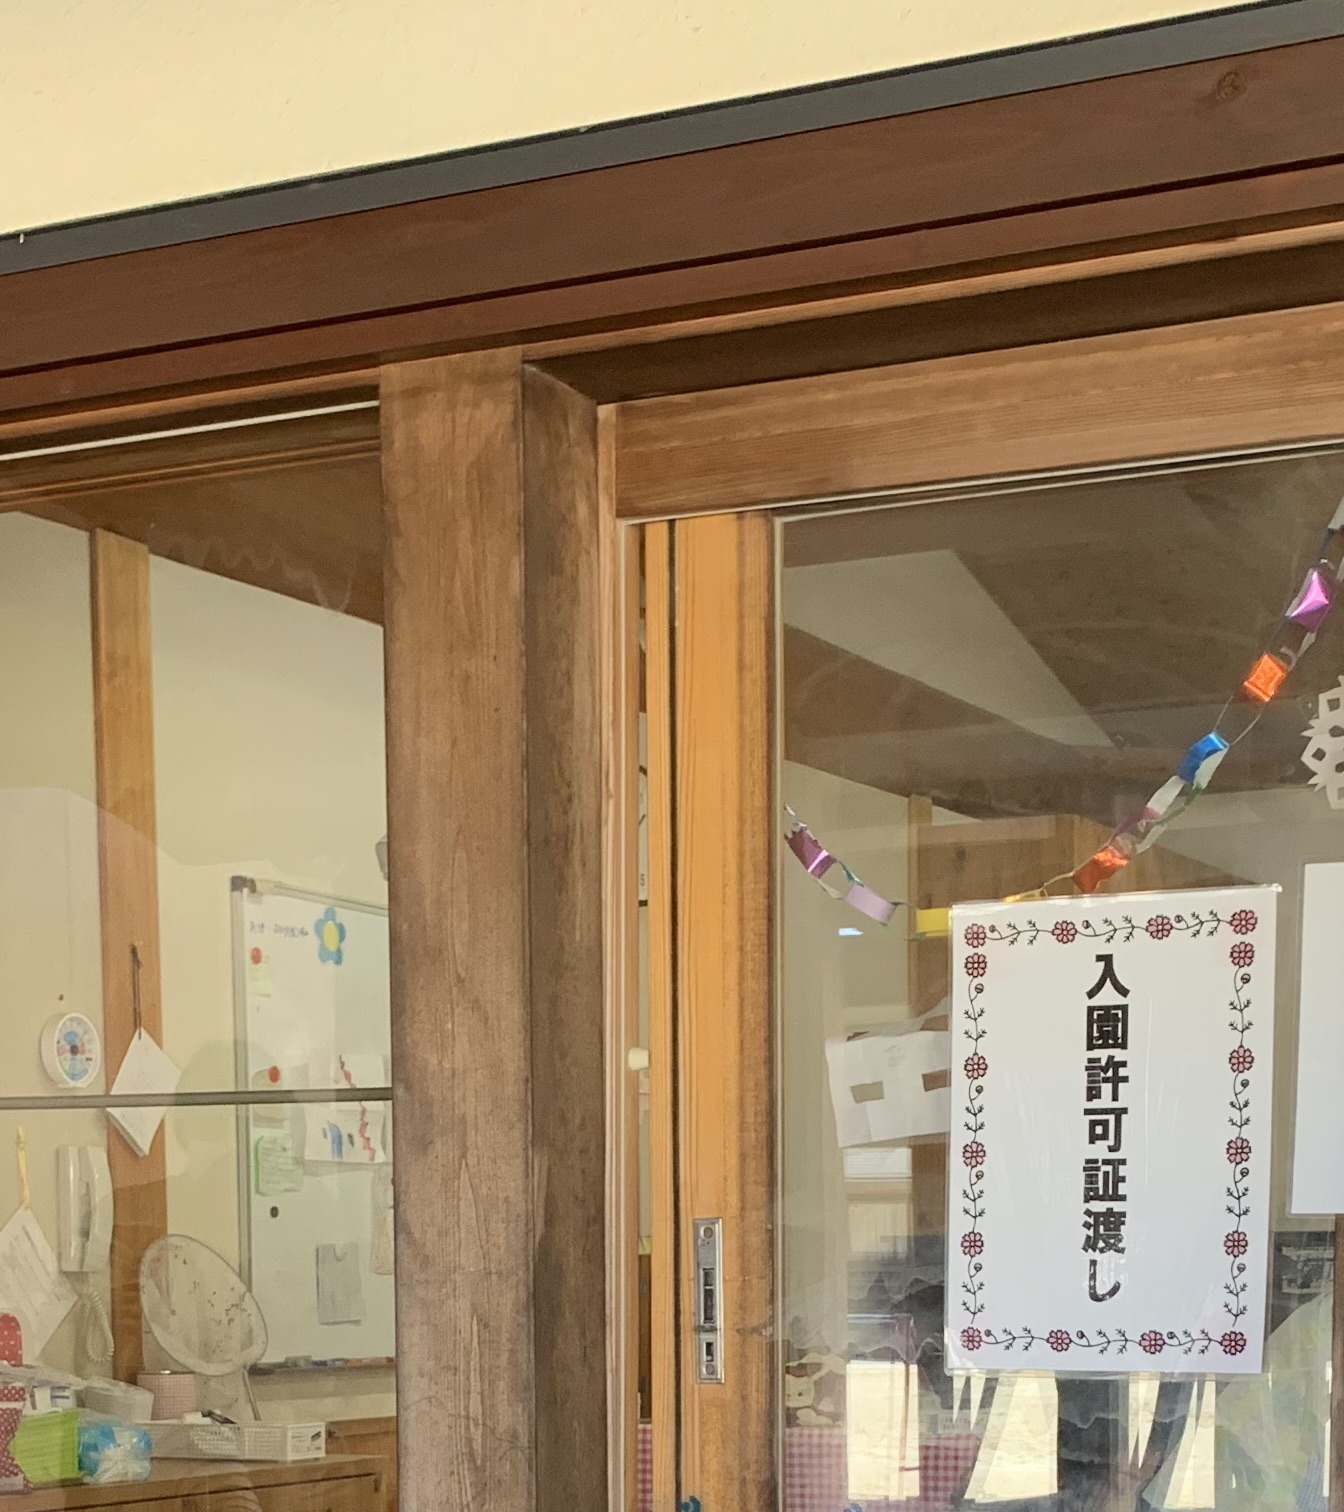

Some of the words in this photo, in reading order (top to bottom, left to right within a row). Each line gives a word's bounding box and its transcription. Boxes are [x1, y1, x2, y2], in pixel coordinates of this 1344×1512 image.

[1082, 953, 1130, 1303] 入園許可証渡し
